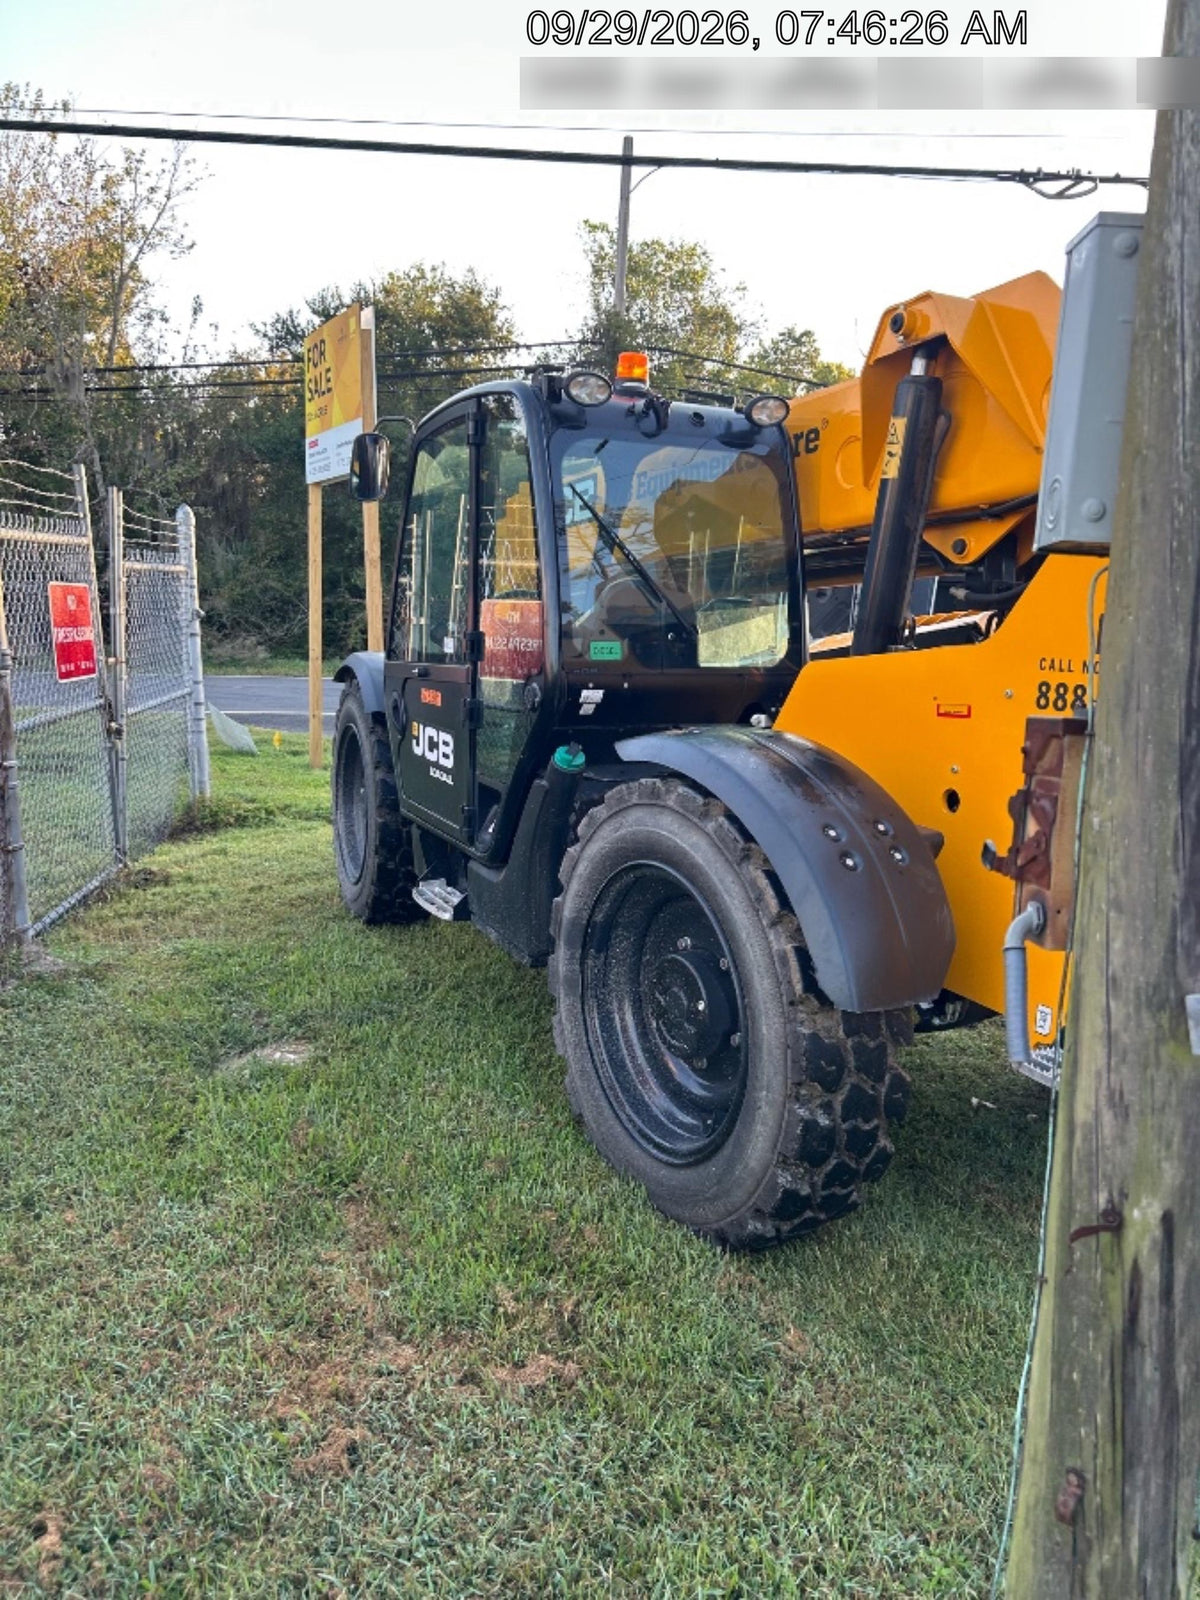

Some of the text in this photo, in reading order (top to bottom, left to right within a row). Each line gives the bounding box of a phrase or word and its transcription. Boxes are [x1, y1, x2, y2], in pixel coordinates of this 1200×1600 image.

[307, 338, 326, 373] FOR
[307, 367, 332, 402] SALE
[1039, 657, 1074, 673] CALL
[411, 721, 454, 769] JCB
